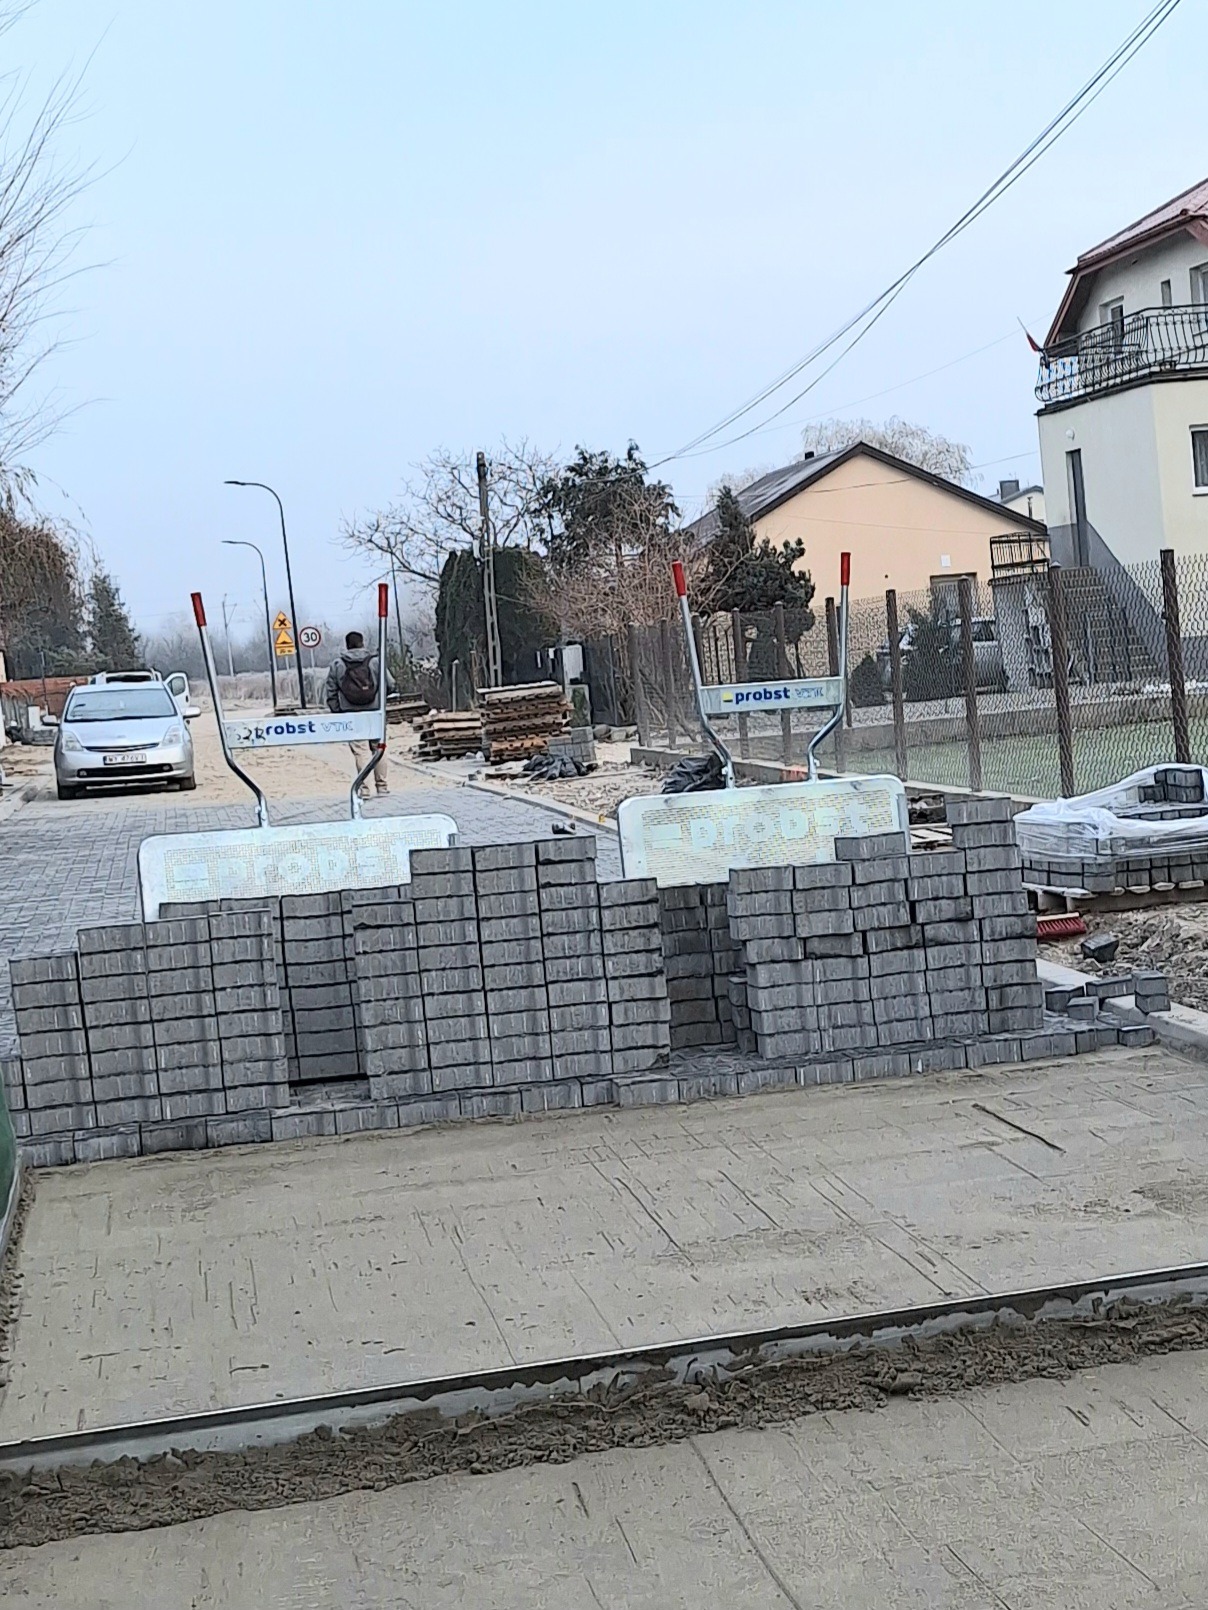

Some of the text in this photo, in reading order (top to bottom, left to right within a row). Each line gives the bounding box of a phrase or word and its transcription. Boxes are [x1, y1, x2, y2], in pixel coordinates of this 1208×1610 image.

[304, 632, 317, 643] 30
[735, 687, 790, 705] probst
[321, 720, 354, 732] VTK
